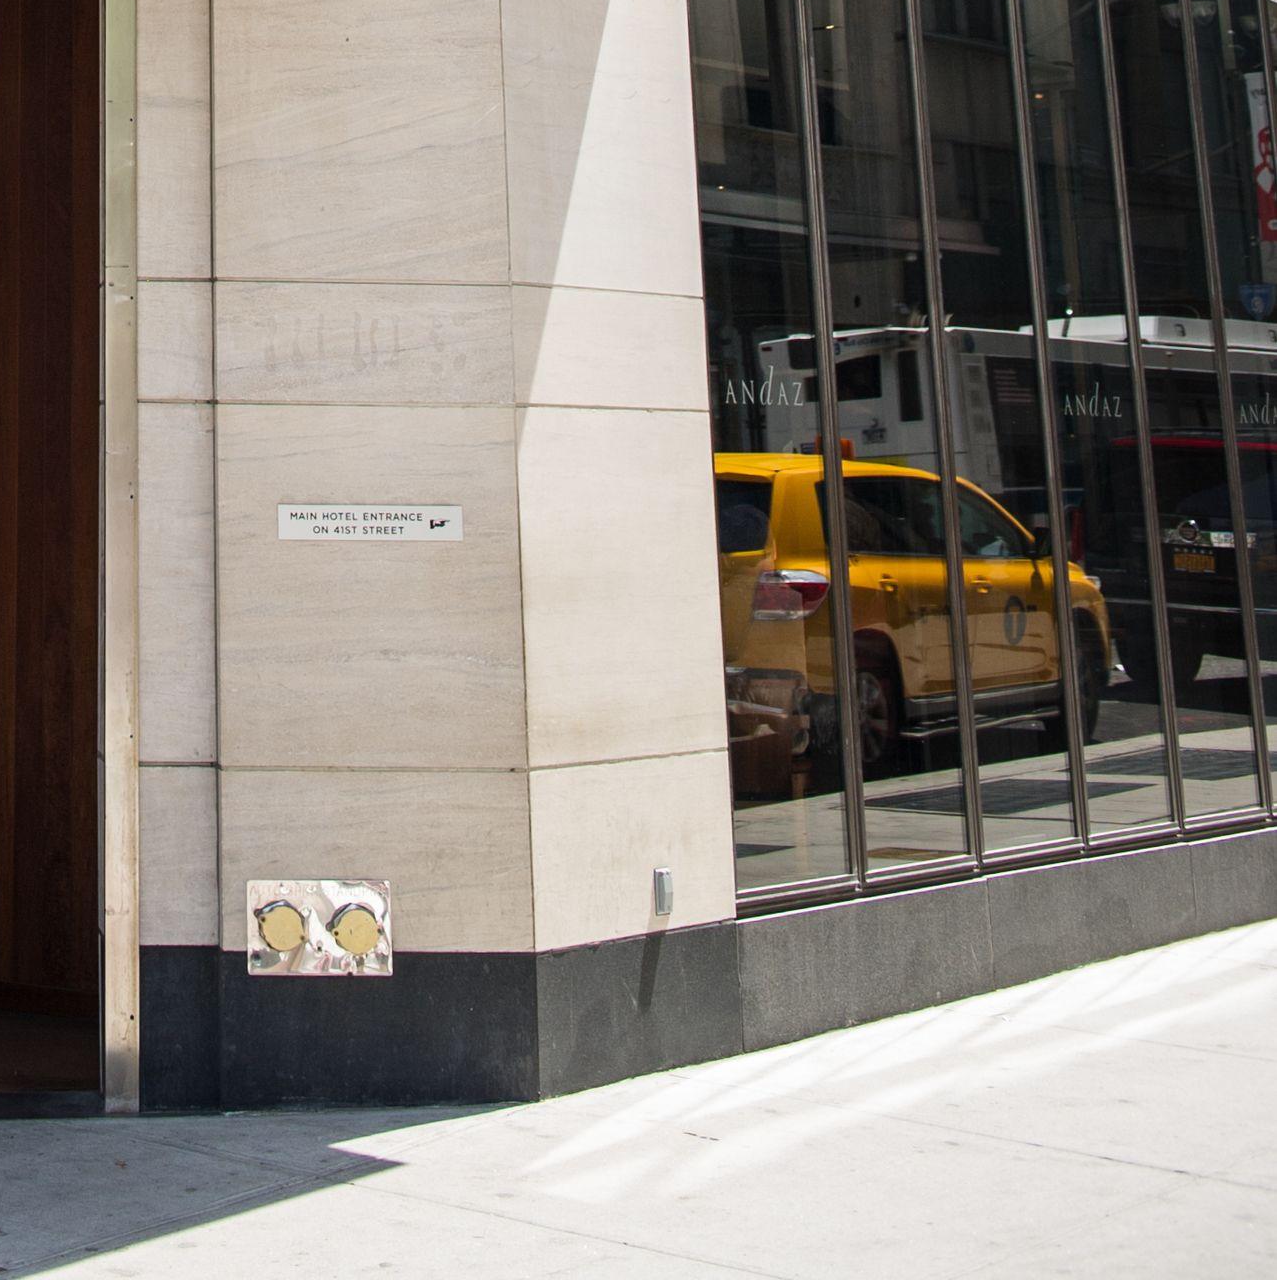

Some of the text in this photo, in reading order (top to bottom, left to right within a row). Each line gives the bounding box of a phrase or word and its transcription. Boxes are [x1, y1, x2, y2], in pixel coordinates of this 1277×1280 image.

[290, 512, 423, 522] MAIN HOTEL ENTRANCE
[312, 525, 405, 535] ON 41ST STREET
